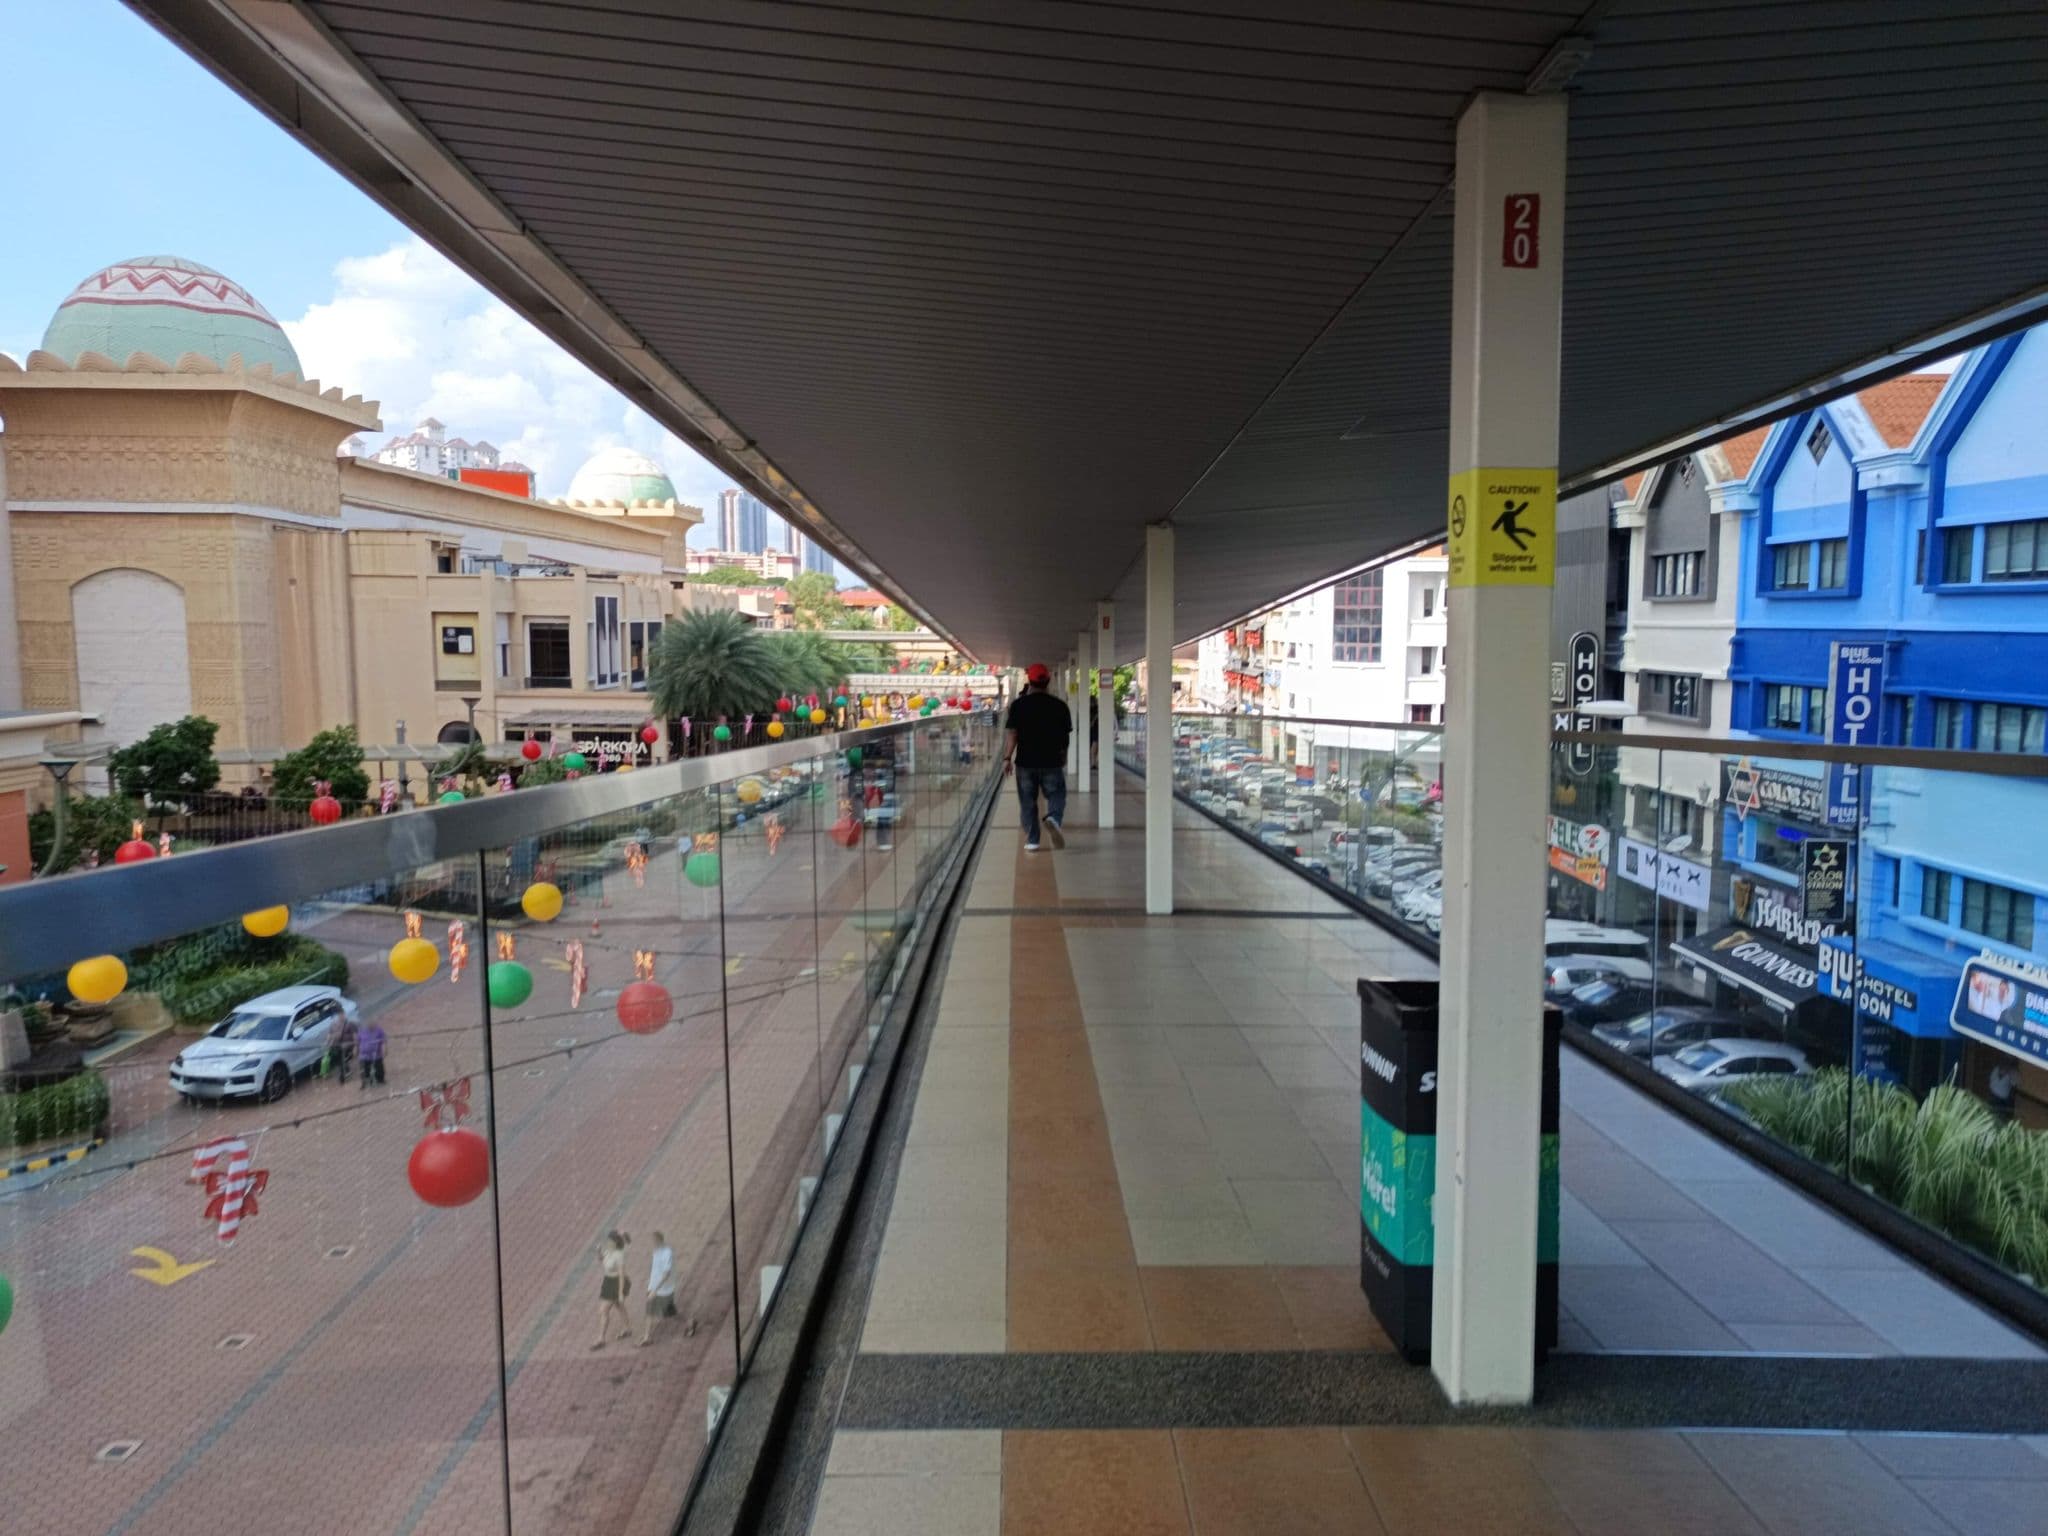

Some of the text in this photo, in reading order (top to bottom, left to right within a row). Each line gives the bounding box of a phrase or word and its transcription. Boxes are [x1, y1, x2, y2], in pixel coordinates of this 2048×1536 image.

[1513, 198, 1531, 264] 20
[1488, 485, 1541, 495] CAUTION!
[1491, 552, 1536, 564] Slippery
[1519, 564, 1537, 572] wet
[1760, 780, 1801, 807] COLOR
[1864, 976, 1913, 1008] HOTEL
